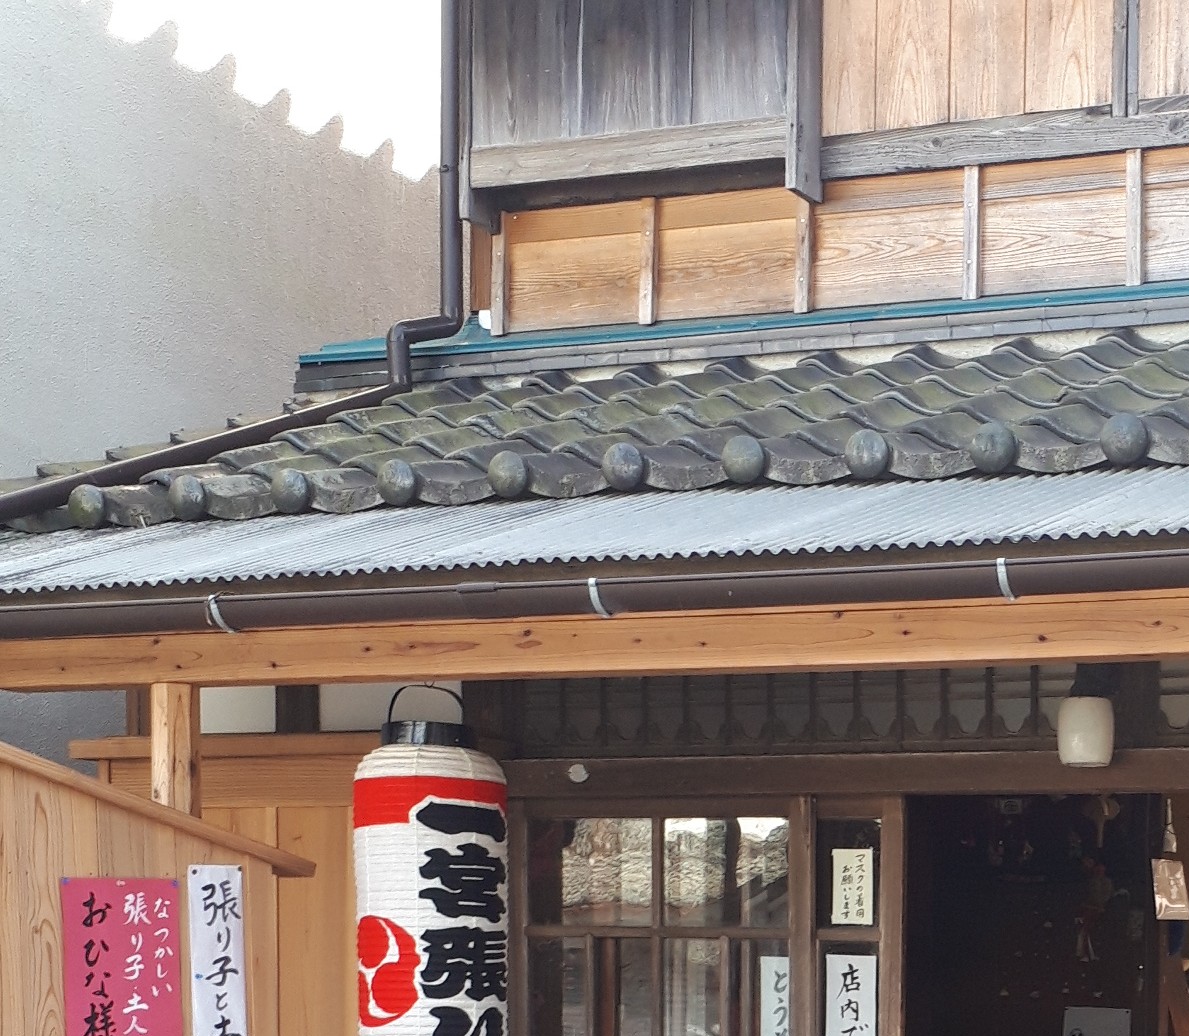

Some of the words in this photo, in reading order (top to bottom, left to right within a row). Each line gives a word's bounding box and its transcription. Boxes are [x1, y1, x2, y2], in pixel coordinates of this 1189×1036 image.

[153, 897, 174, 997] なつかしい
